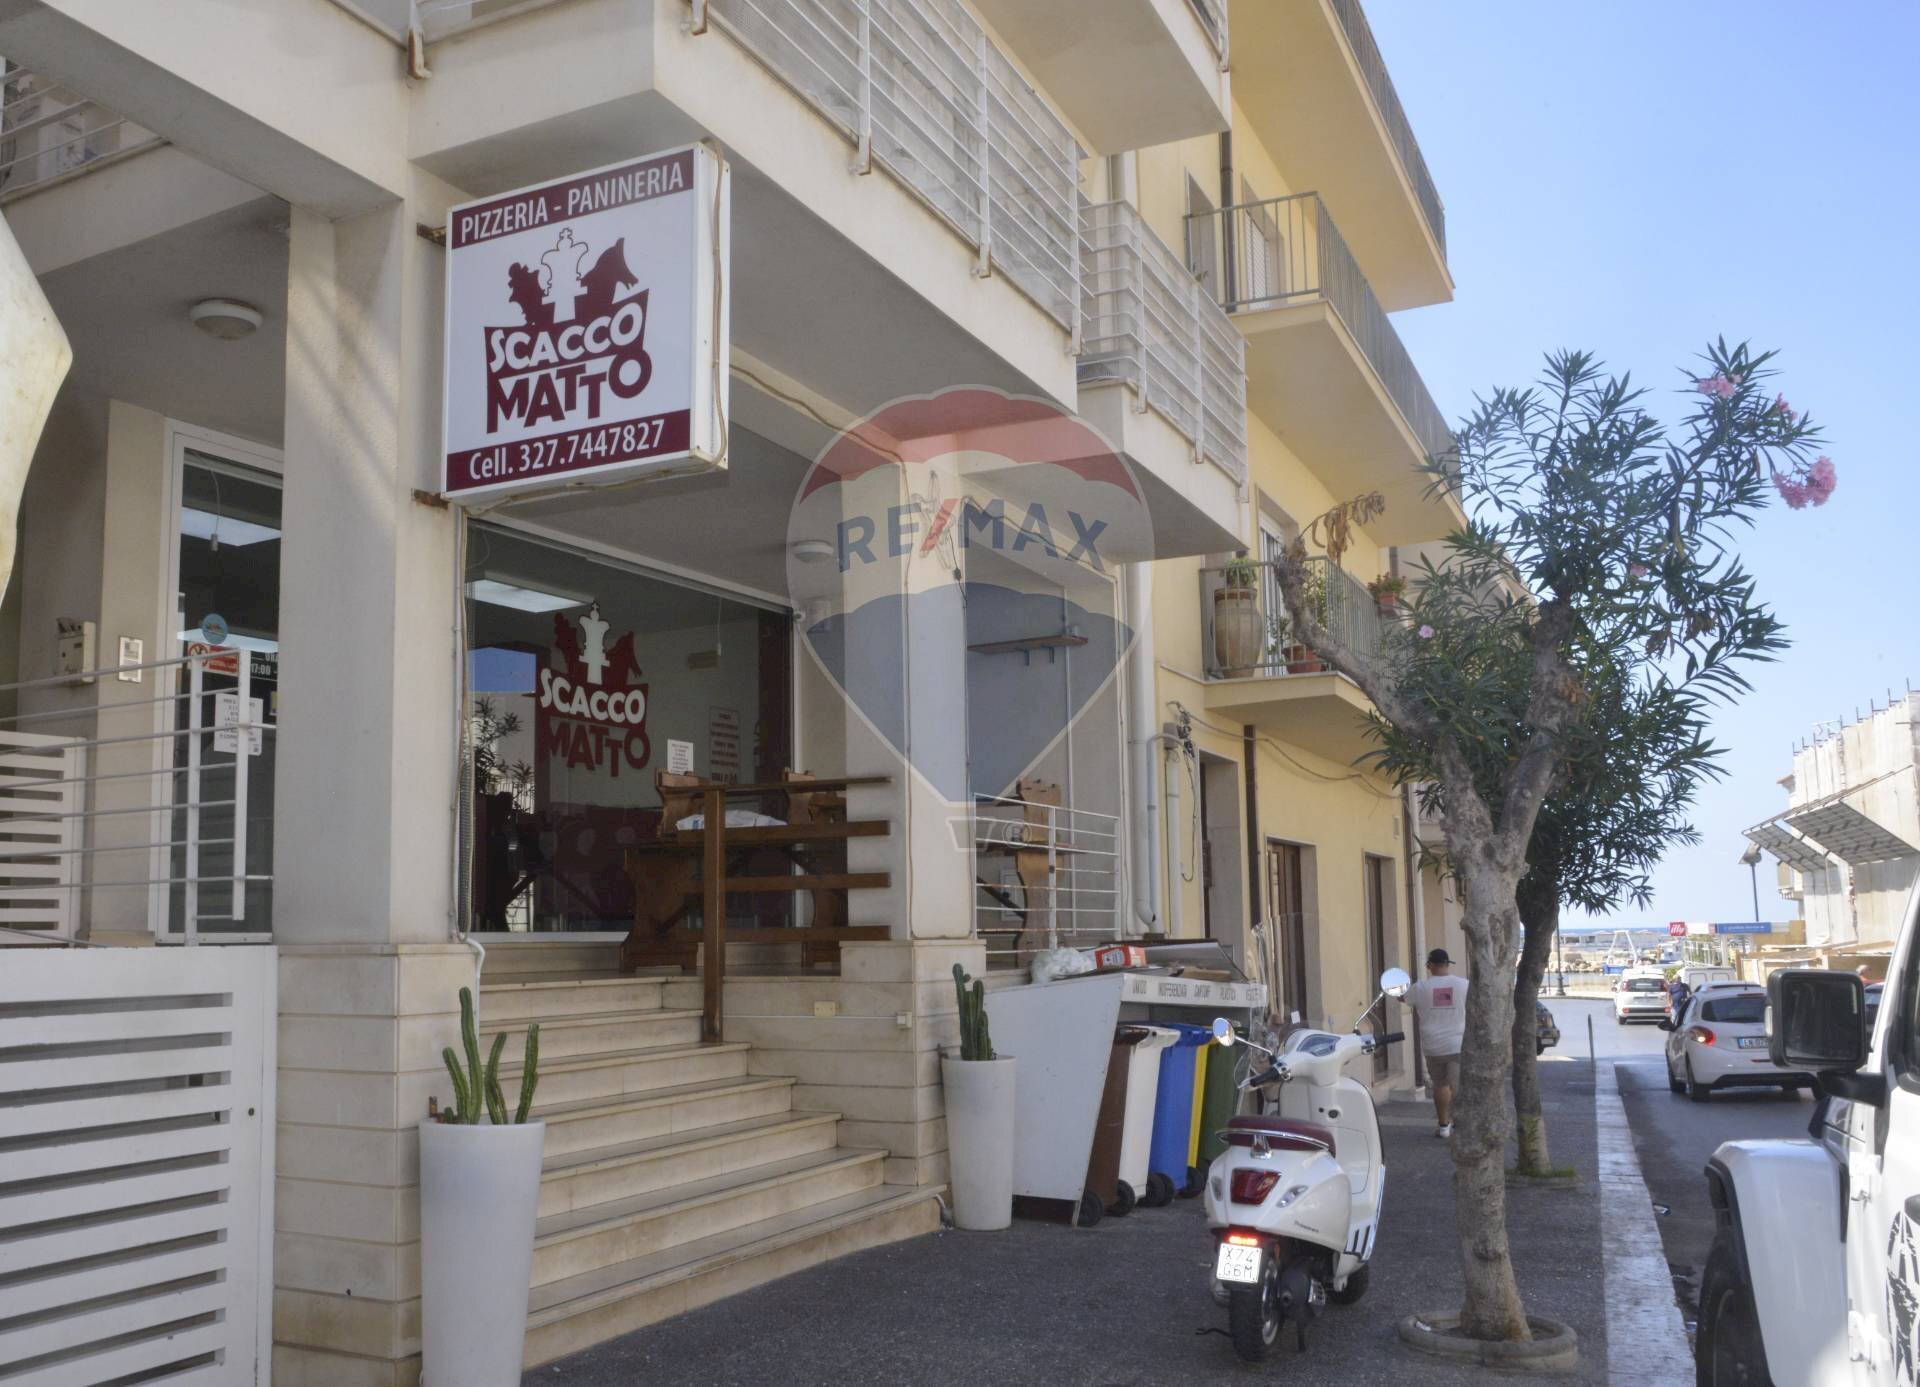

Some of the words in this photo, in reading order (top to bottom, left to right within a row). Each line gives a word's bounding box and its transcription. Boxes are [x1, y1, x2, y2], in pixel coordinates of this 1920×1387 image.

[461, 197, 548, 244] PIZZERIA
[567, 162, 683, 216] PANINERIA
[489, 302, 643, 373] SCACCO
[486, 349, 652, 434] MATTO
[469, 451, 513, 480] Cell.
[519, 419, 664, 472] 327.7447827
[540, 668, 646, 724] SCACCO
[540, 721, 650, 777] MATTO
